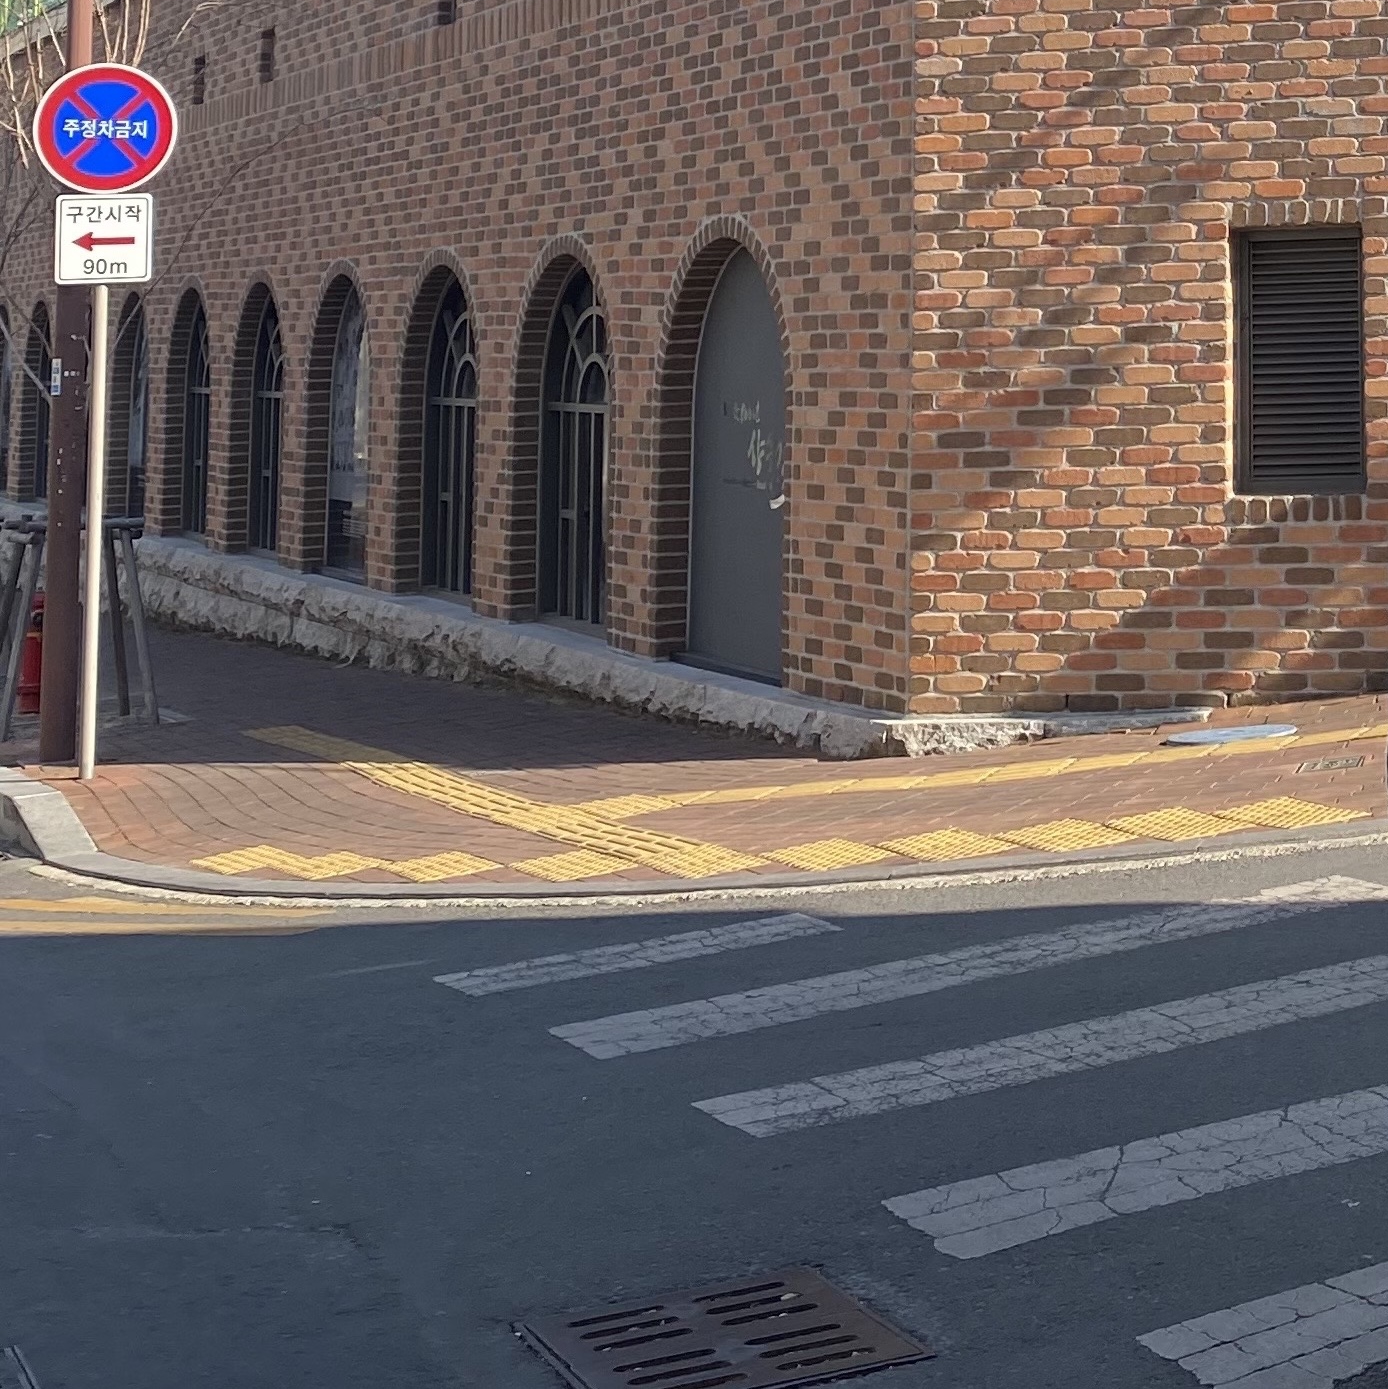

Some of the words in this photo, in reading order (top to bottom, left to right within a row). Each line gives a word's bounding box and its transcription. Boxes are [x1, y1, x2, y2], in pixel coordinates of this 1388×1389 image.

[62, 118, 149, 139] 주정차금지
[65, 204, 142, 224] 구간시작
[83, 259, 128, 275] 90m
